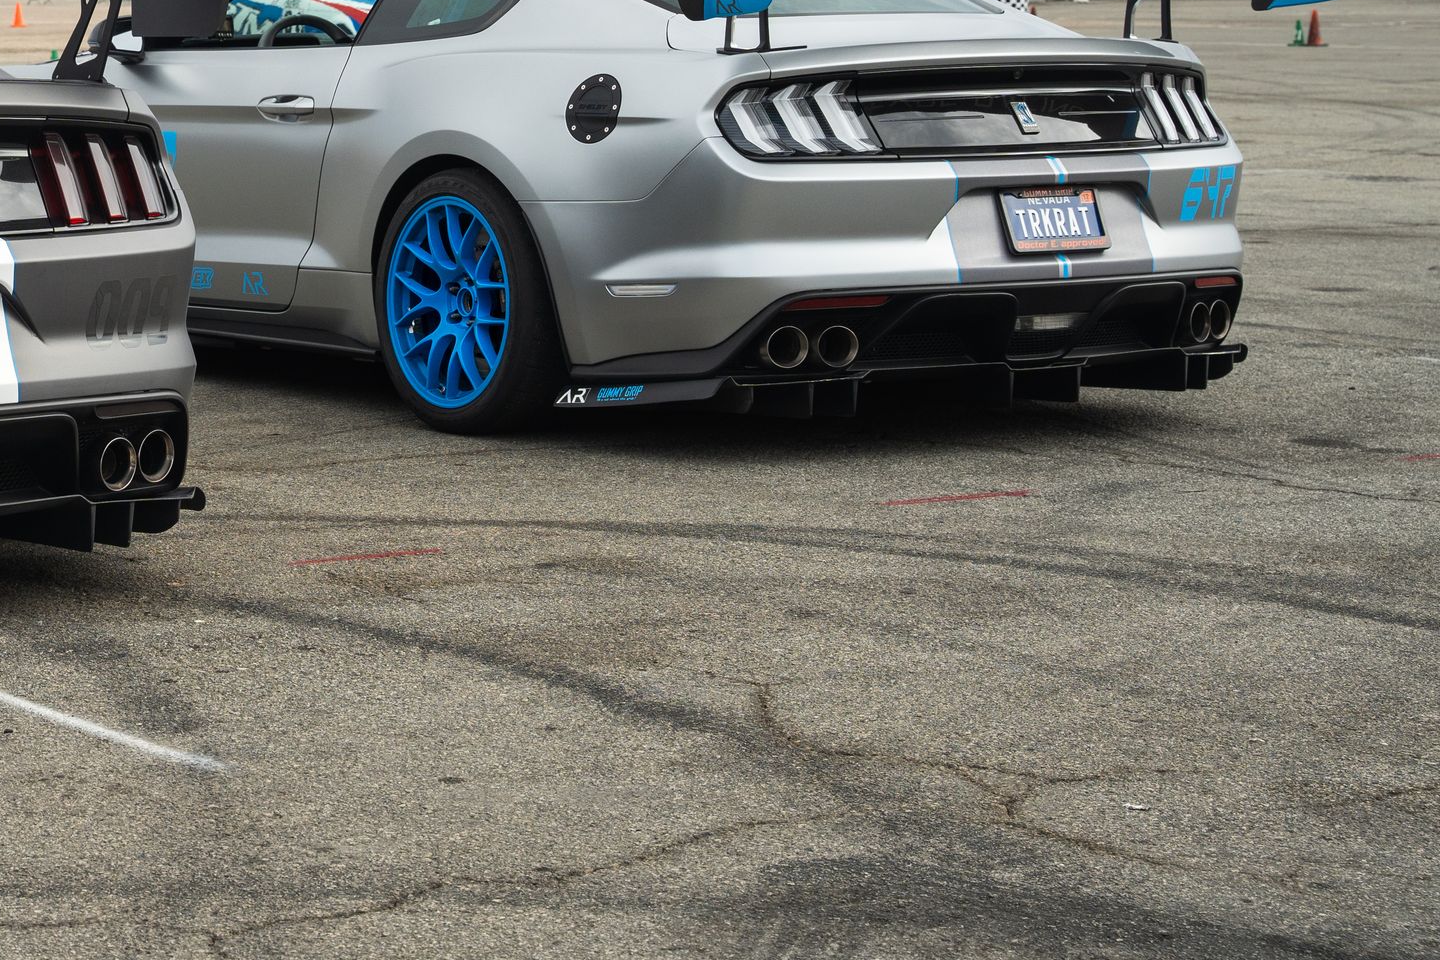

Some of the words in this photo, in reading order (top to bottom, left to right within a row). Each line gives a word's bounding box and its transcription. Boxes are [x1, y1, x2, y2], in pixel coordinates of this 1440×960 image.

[1027, 196, 1071, 205] NEVADA
[1015, 206, 1092, 239] TRKRAT
[1018, 241, 1048, 250] Doctor
[596, 387, 626, 399] GUMMY
[625, 385, 643, 397] GRIP
